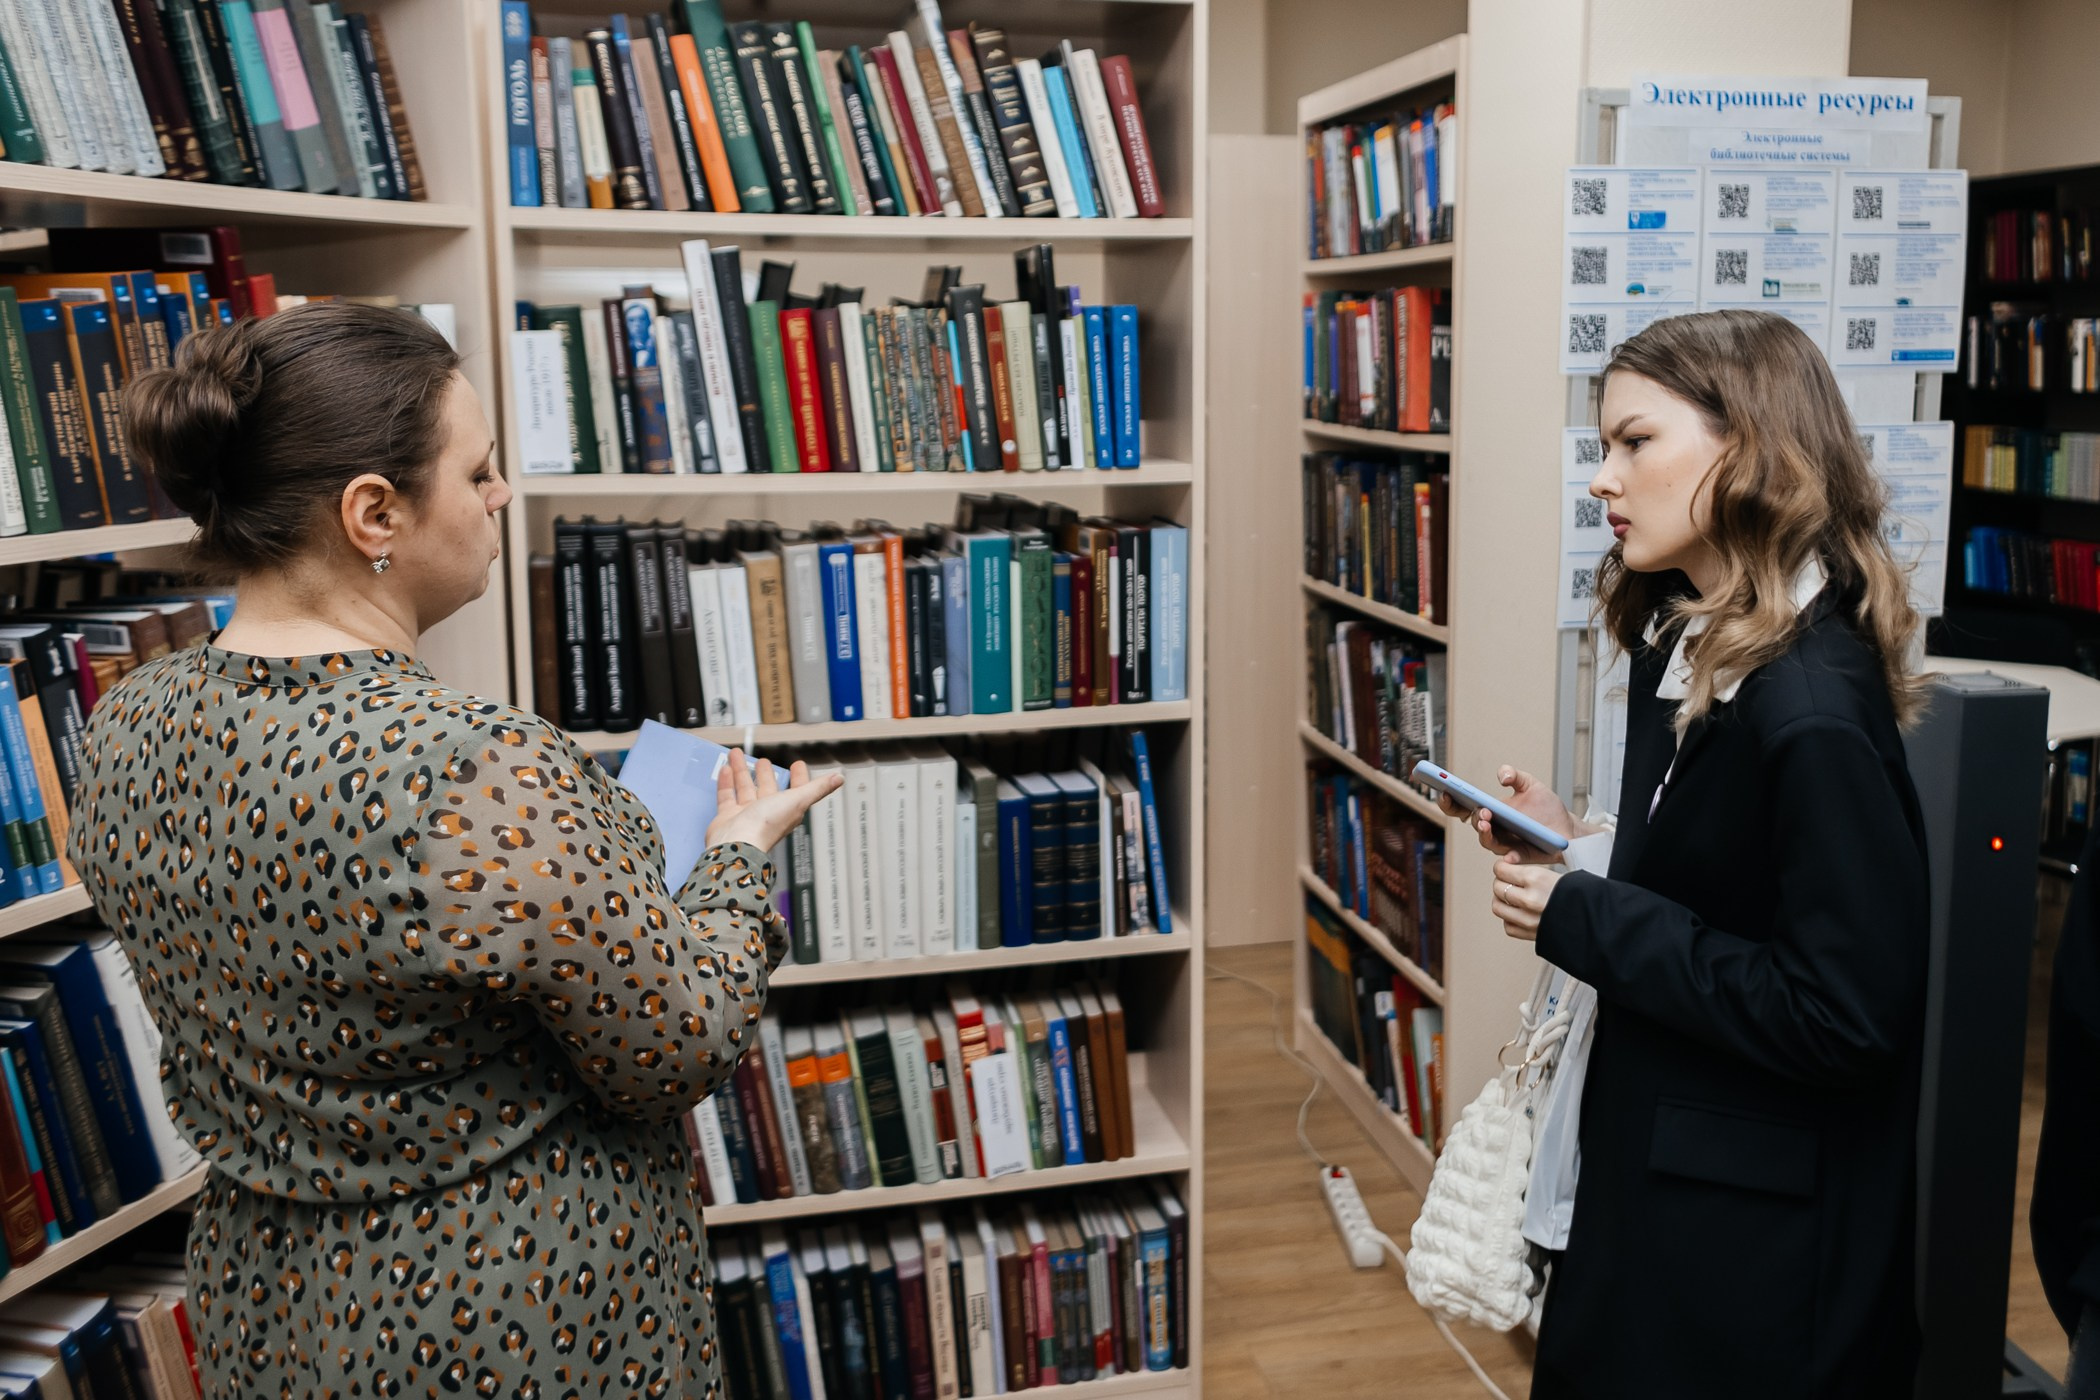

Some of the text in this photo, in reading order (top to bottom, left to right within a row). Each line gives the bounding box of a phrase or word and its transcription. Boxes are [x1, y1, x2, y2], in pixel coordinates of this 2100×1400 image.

[509, 58, 529, 126] ГОГОЛЬ
[1642, 82, 1914, 117] Электронные ресурсы
[1709, 147, 1850, 162] библиотечные системы
[1741, 130, 1823, 147] Электронные
[1137, 573, 1145, 649] ПОРТРЕТЫ ПОЭТОВ
[1172, 571, 1180, 647] ПОРТРЕТЫ ПОЭТОВ
[571, 644, 587, 711] Андрей Белый
[607, 644, 622, 711] Андрей Белый
[686, 707, 699, 721] 2
[48, 871, 58, 884] 2
